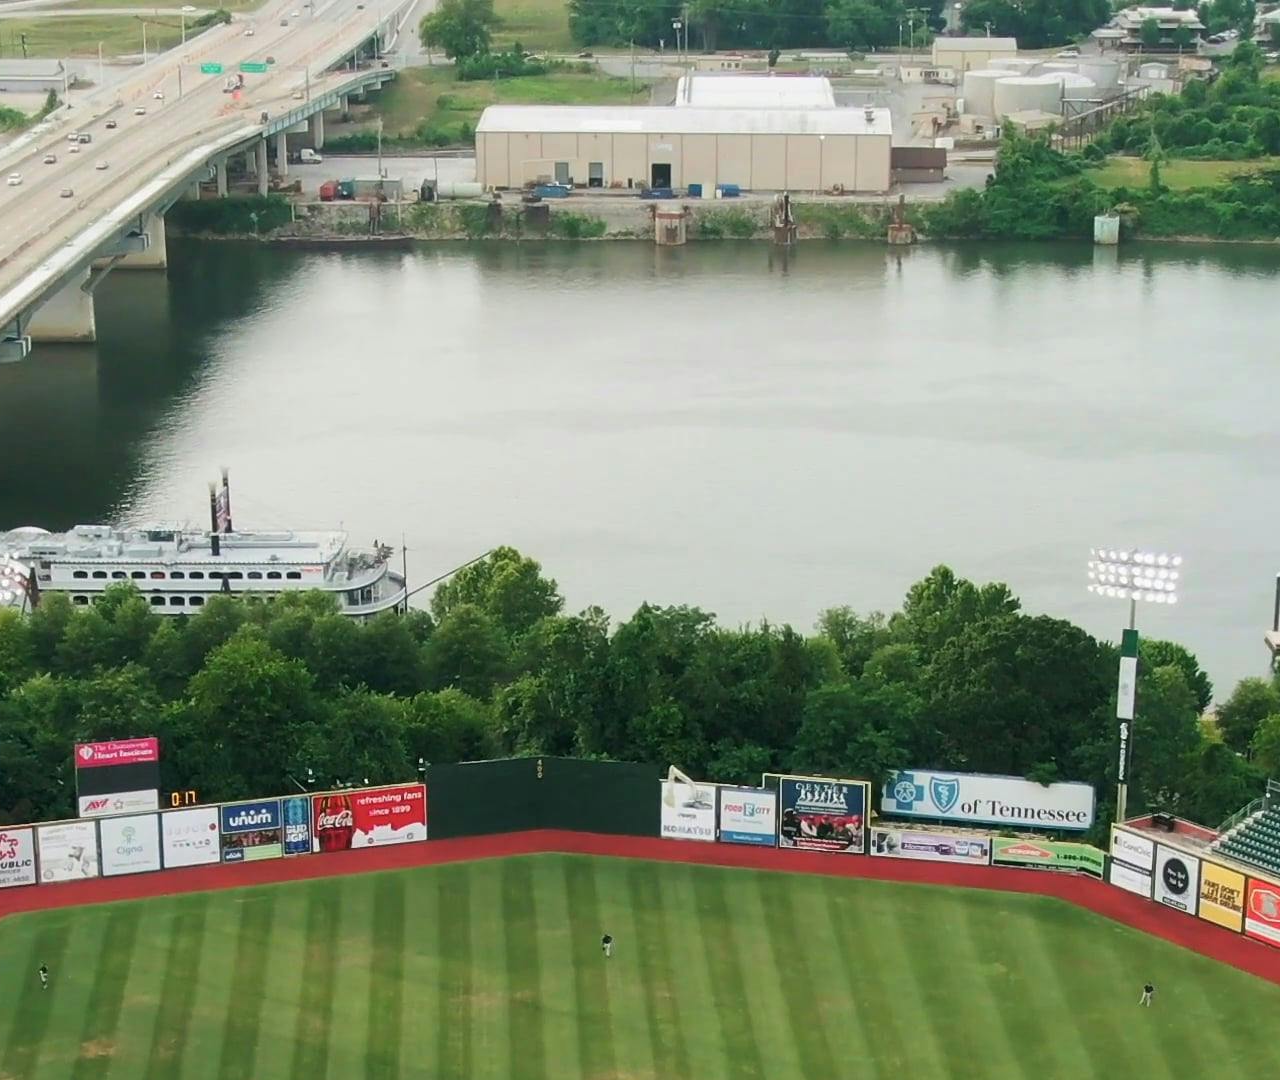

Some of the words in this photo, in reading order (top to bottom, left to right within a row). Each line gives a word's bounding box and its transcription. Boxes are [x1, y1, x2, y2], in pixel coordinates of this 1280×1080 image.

[94, 751, 118, 760] Heart
[357, 794, 402, 806] refreshing
[403, 791, 422, 801] fans
[369, 808, 389, 816] since
[725, 803, 743, 812] FOOD
[755, 807, 771, 815] CITY
[960, 799, 980, 814] of
[986, 800, 1087, 824] Tennessee
[229, 809, 272, 827] unum
[663, 824, 711, 836] KOMATSU
